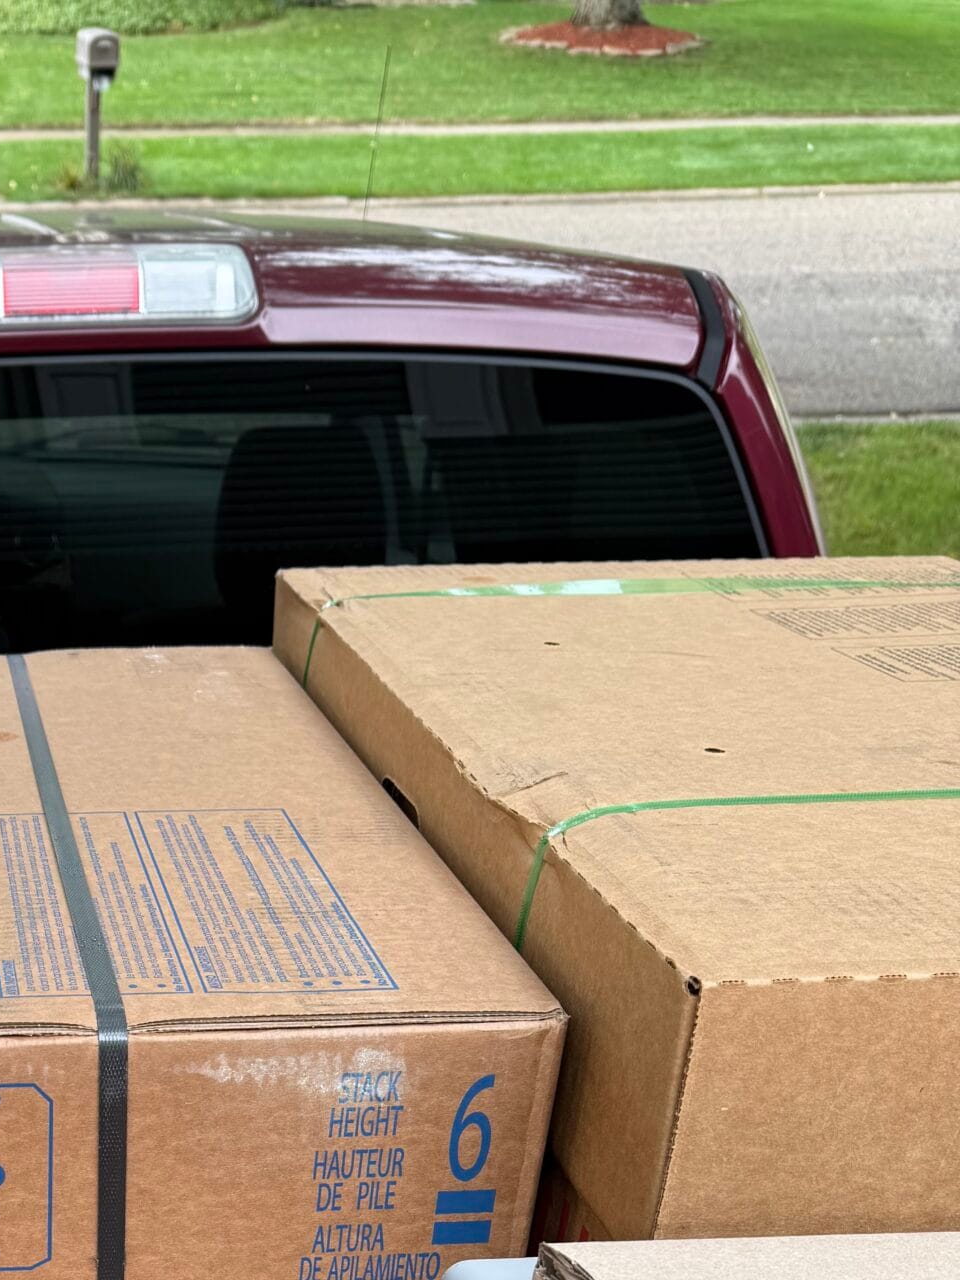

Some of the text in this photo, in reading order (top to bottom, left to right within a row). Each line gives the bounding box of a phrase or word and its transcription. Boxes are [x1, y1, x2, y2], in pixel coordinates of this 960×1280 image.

[338, 1071, 402, 1104] STACK
[328, 1105, 403, 1138] HEIGHT
[448, 1074, 496, 1182] 6
[312, 1147, 404, 1180] HAUTEUR
[315, 1181, 396, 1212] DE PILE
[311, 1223, 385, 1254] ALTURA
